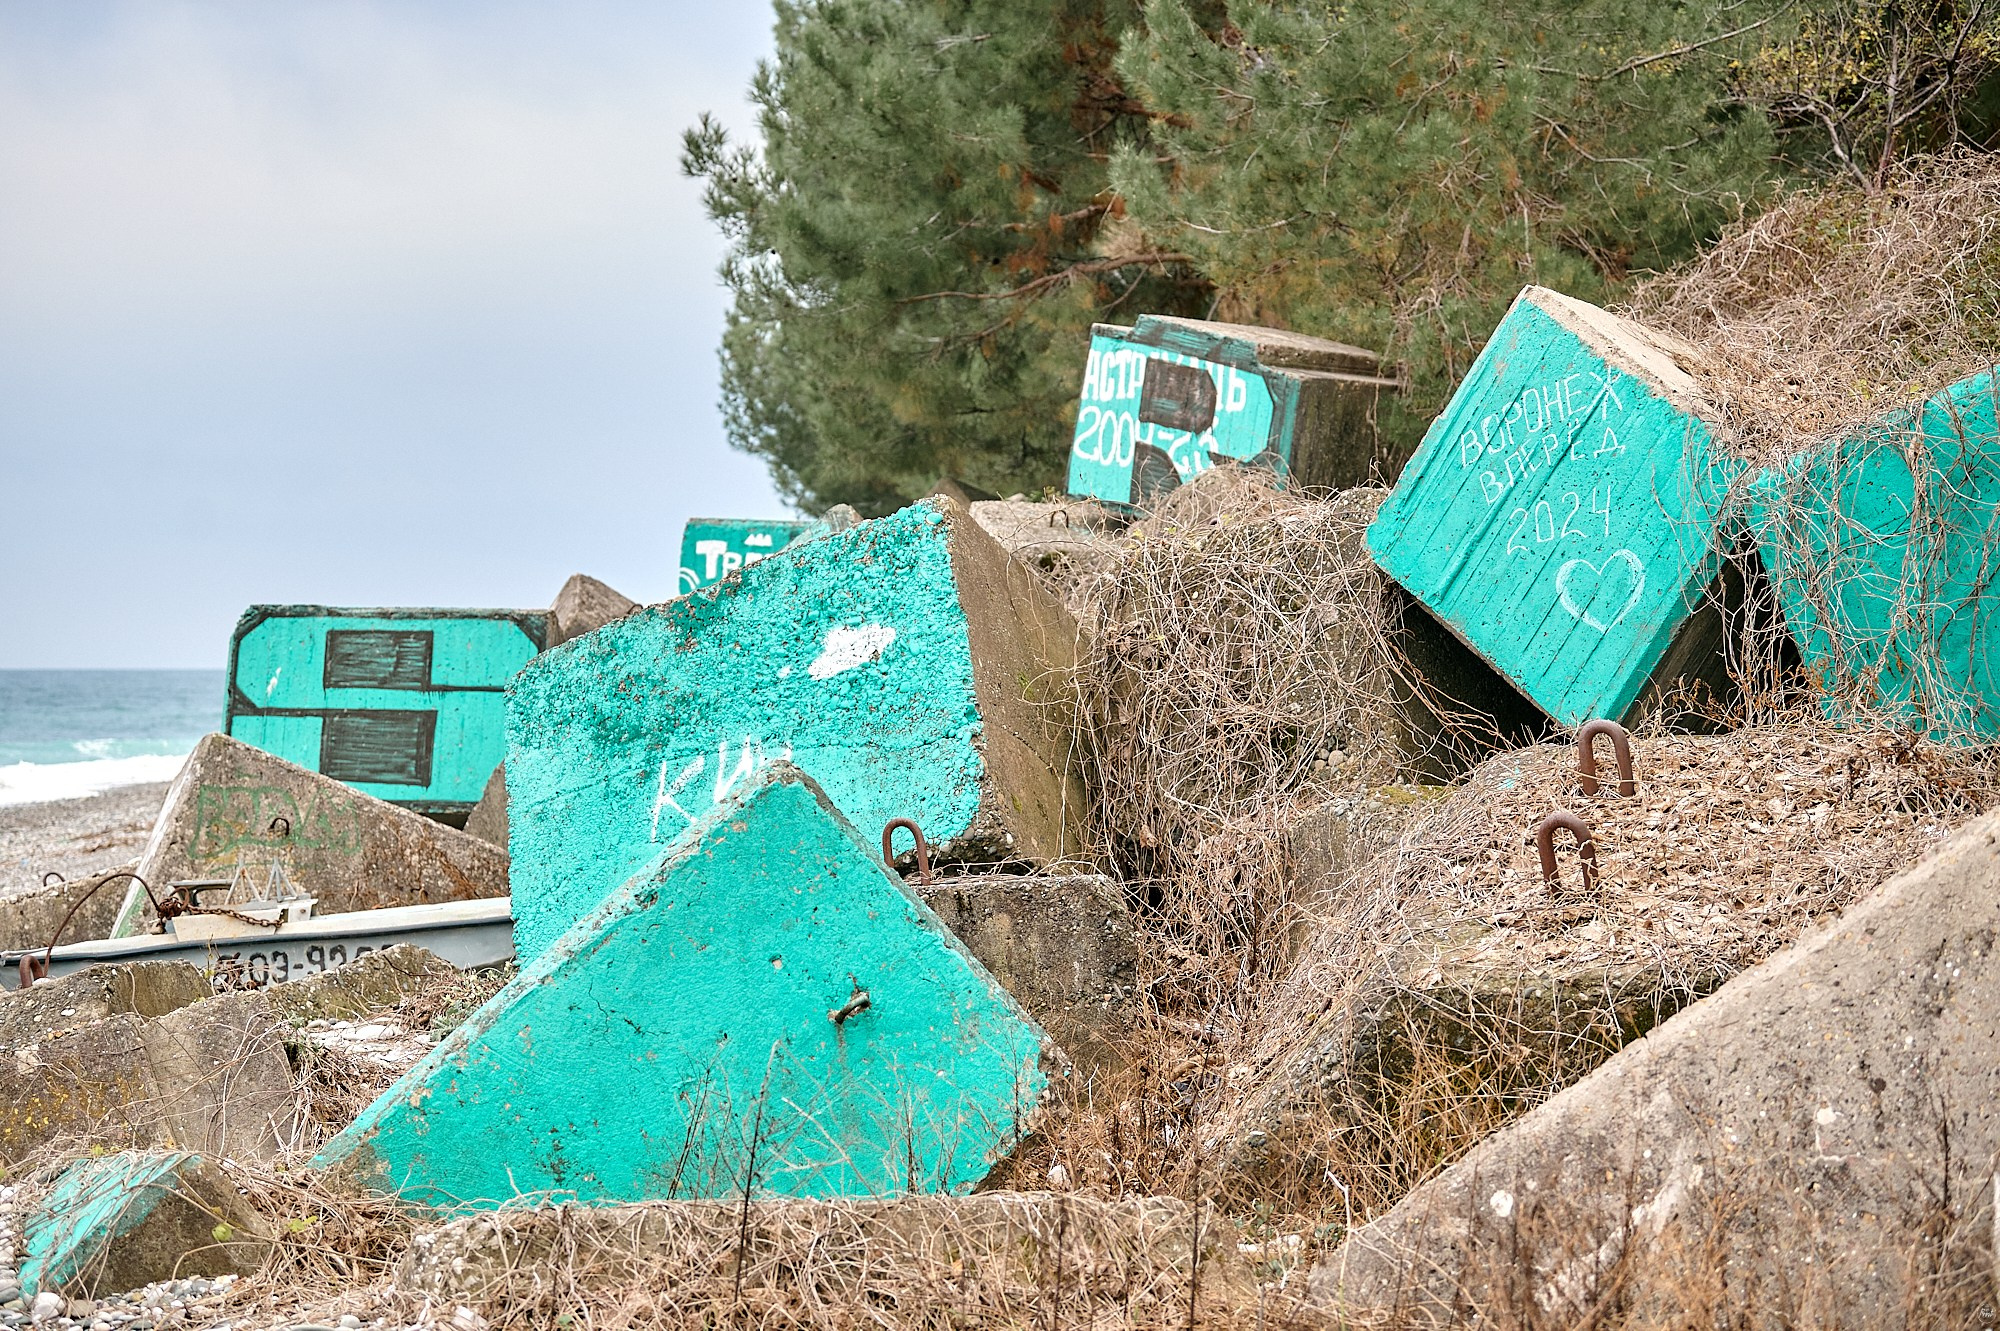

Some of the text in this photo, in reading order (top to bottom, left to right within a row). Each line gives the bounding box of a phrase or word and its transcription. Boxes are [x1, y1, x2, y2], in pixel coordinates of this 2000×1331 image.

[1081, 350, 1247, 413] АСТРНЬ
[1460, 365, 1623, 469] ВОРОНЕЖ
[1506, 485, 1612, 555] 2024
